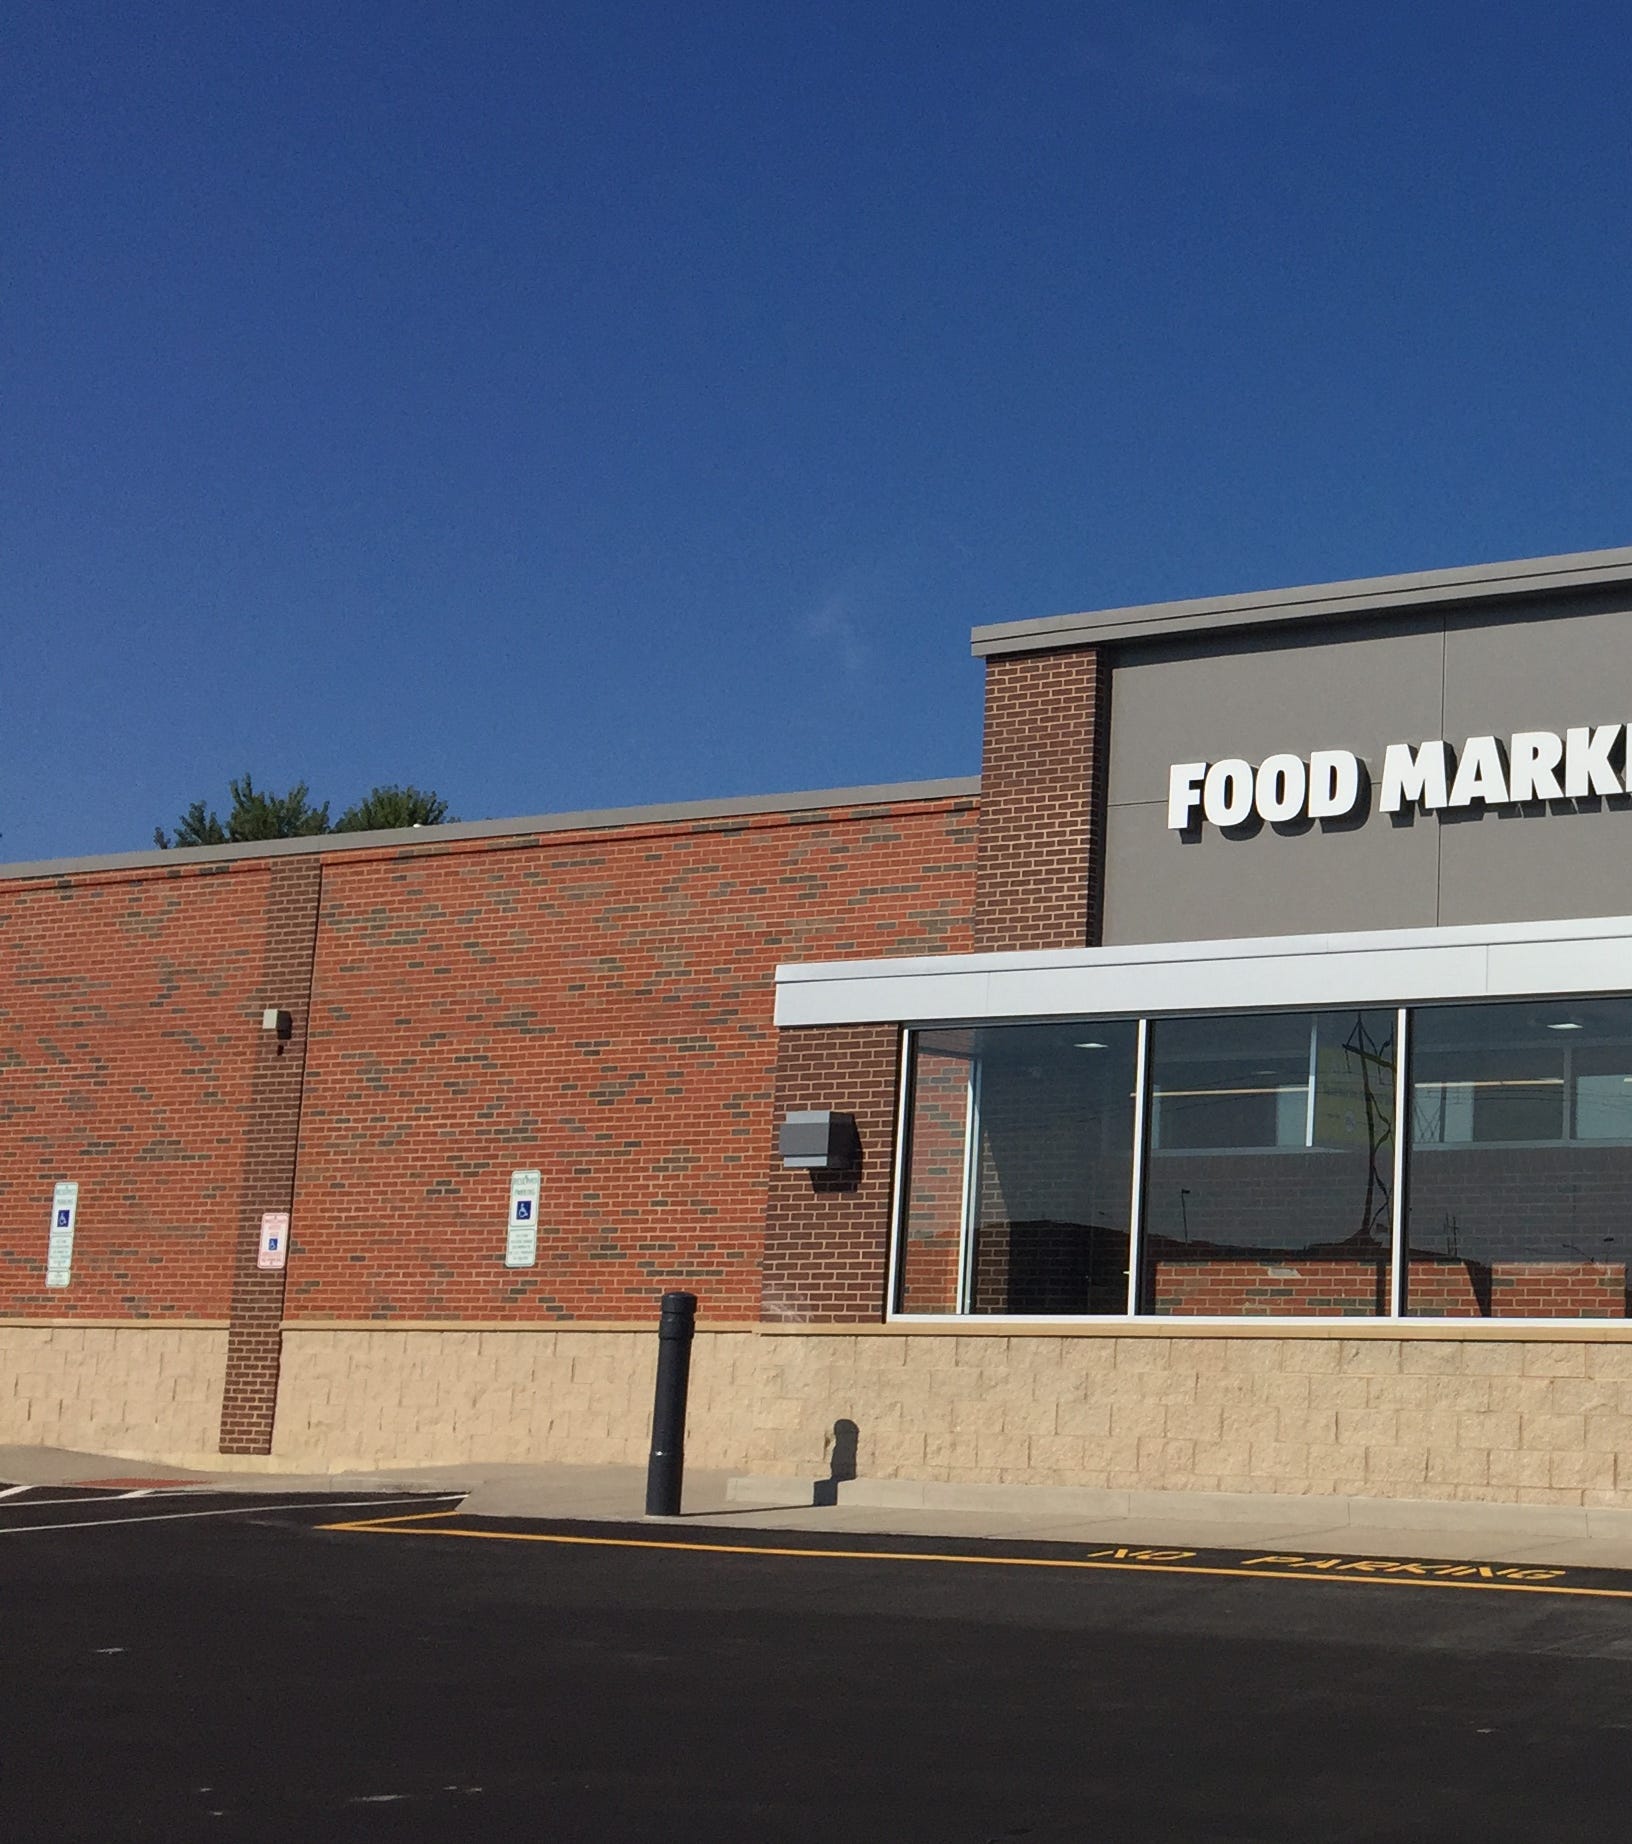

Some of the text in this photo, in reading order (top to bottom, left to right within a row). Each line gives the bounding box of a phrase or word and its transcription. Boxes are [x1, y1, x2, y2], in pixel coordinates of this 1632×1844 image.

[1167, 749, 1358, 829] FOOD
[1087, 1548, 1567, 1581] NO PARKING
